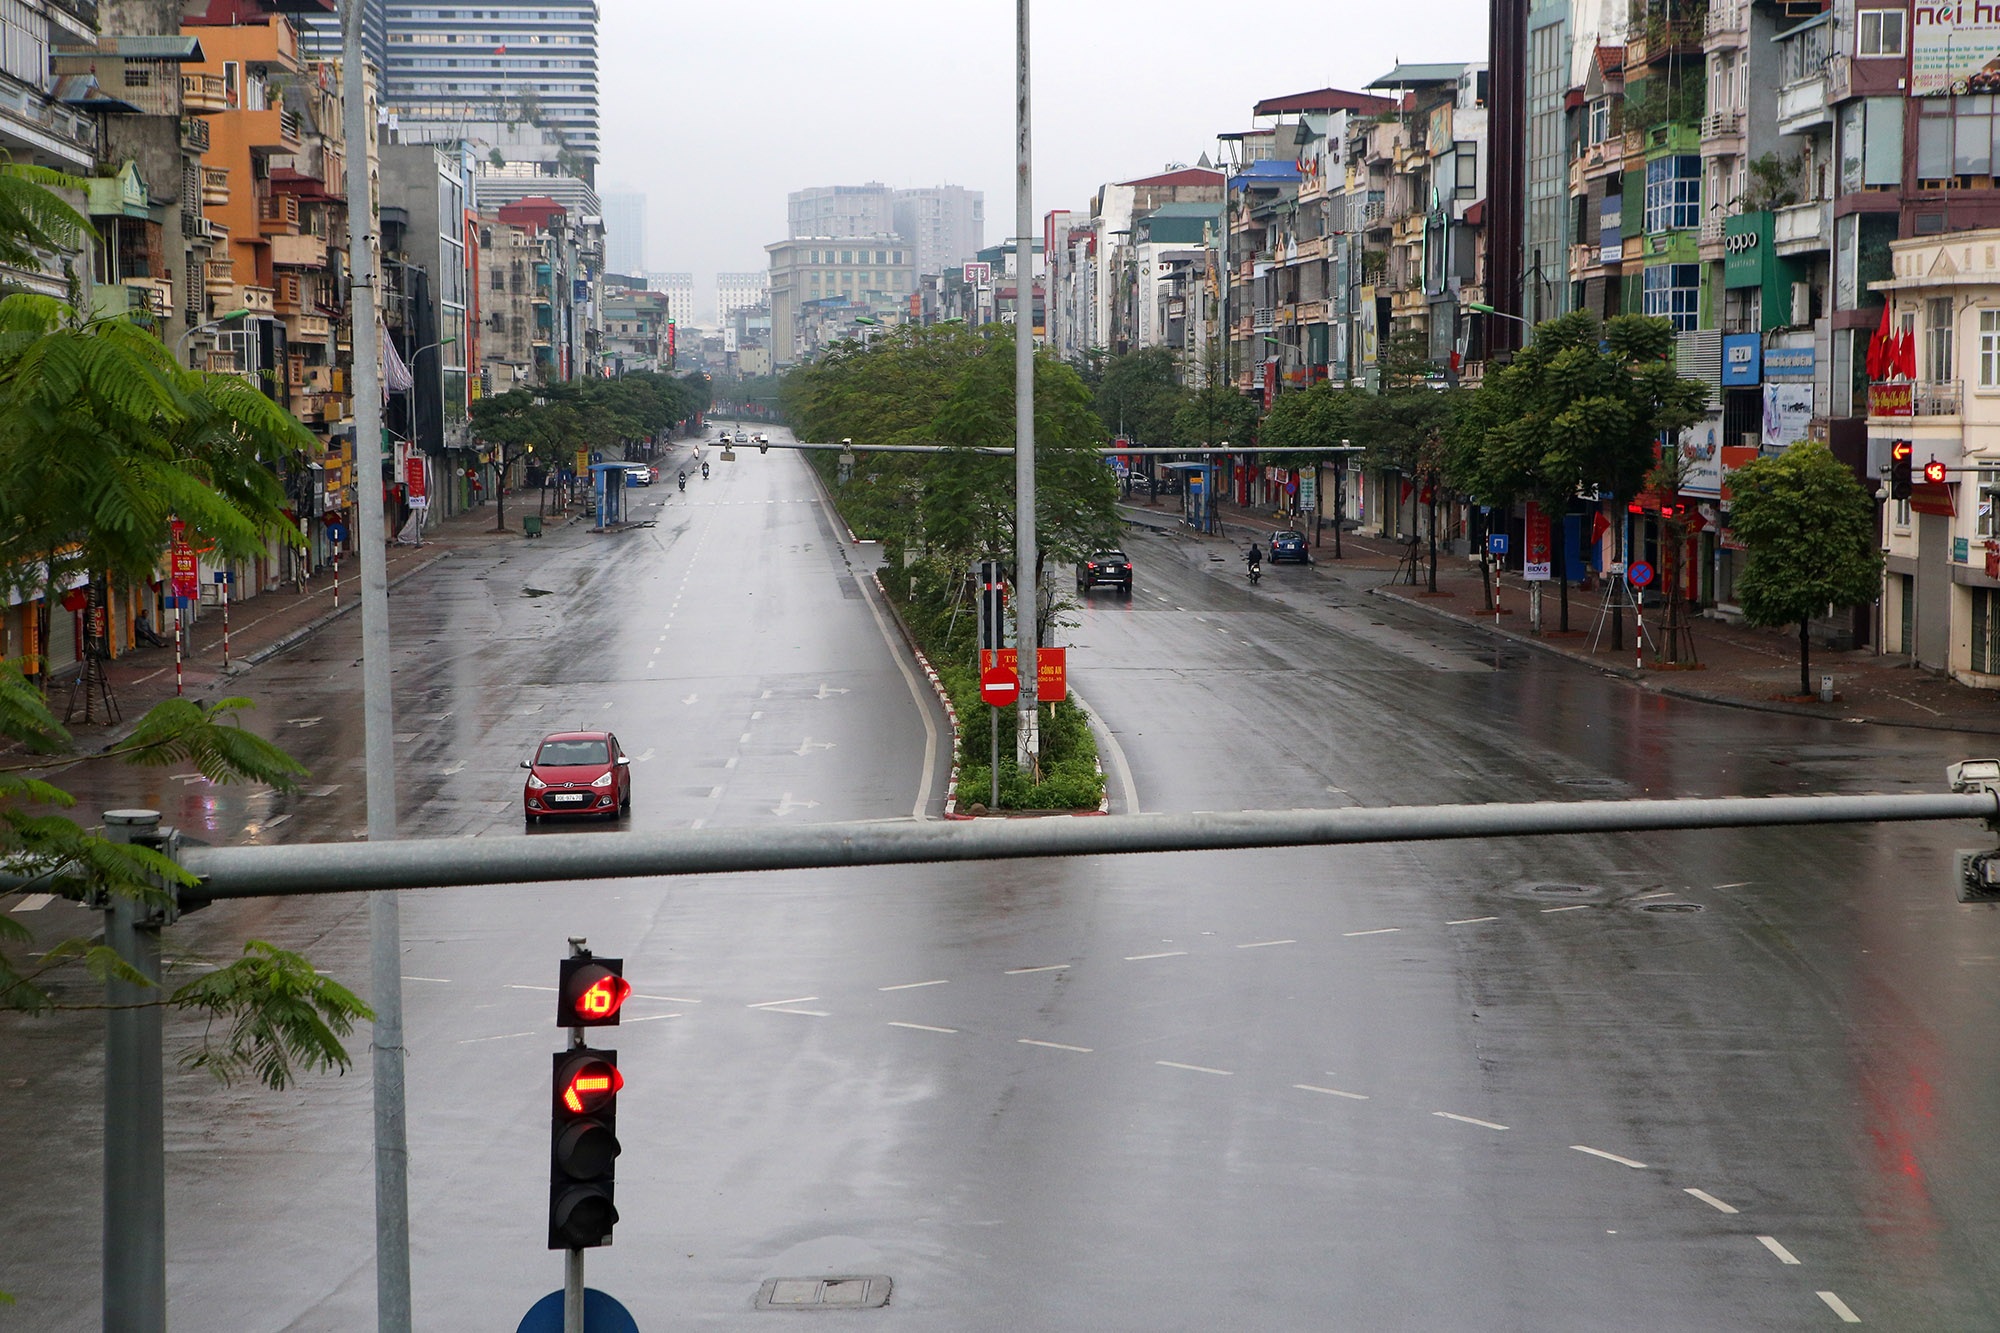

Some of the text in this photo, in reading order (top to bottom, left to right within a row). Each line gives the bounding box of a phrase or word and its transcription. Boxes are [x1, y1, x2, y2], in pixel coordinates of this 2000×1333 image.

[1725, 231, 1757, 254] oppo
[1927, 465, 1942, 480] 46
[1041, 665, 1054, 674] CÔNG
[1055, 666, 1062, 674] AN
